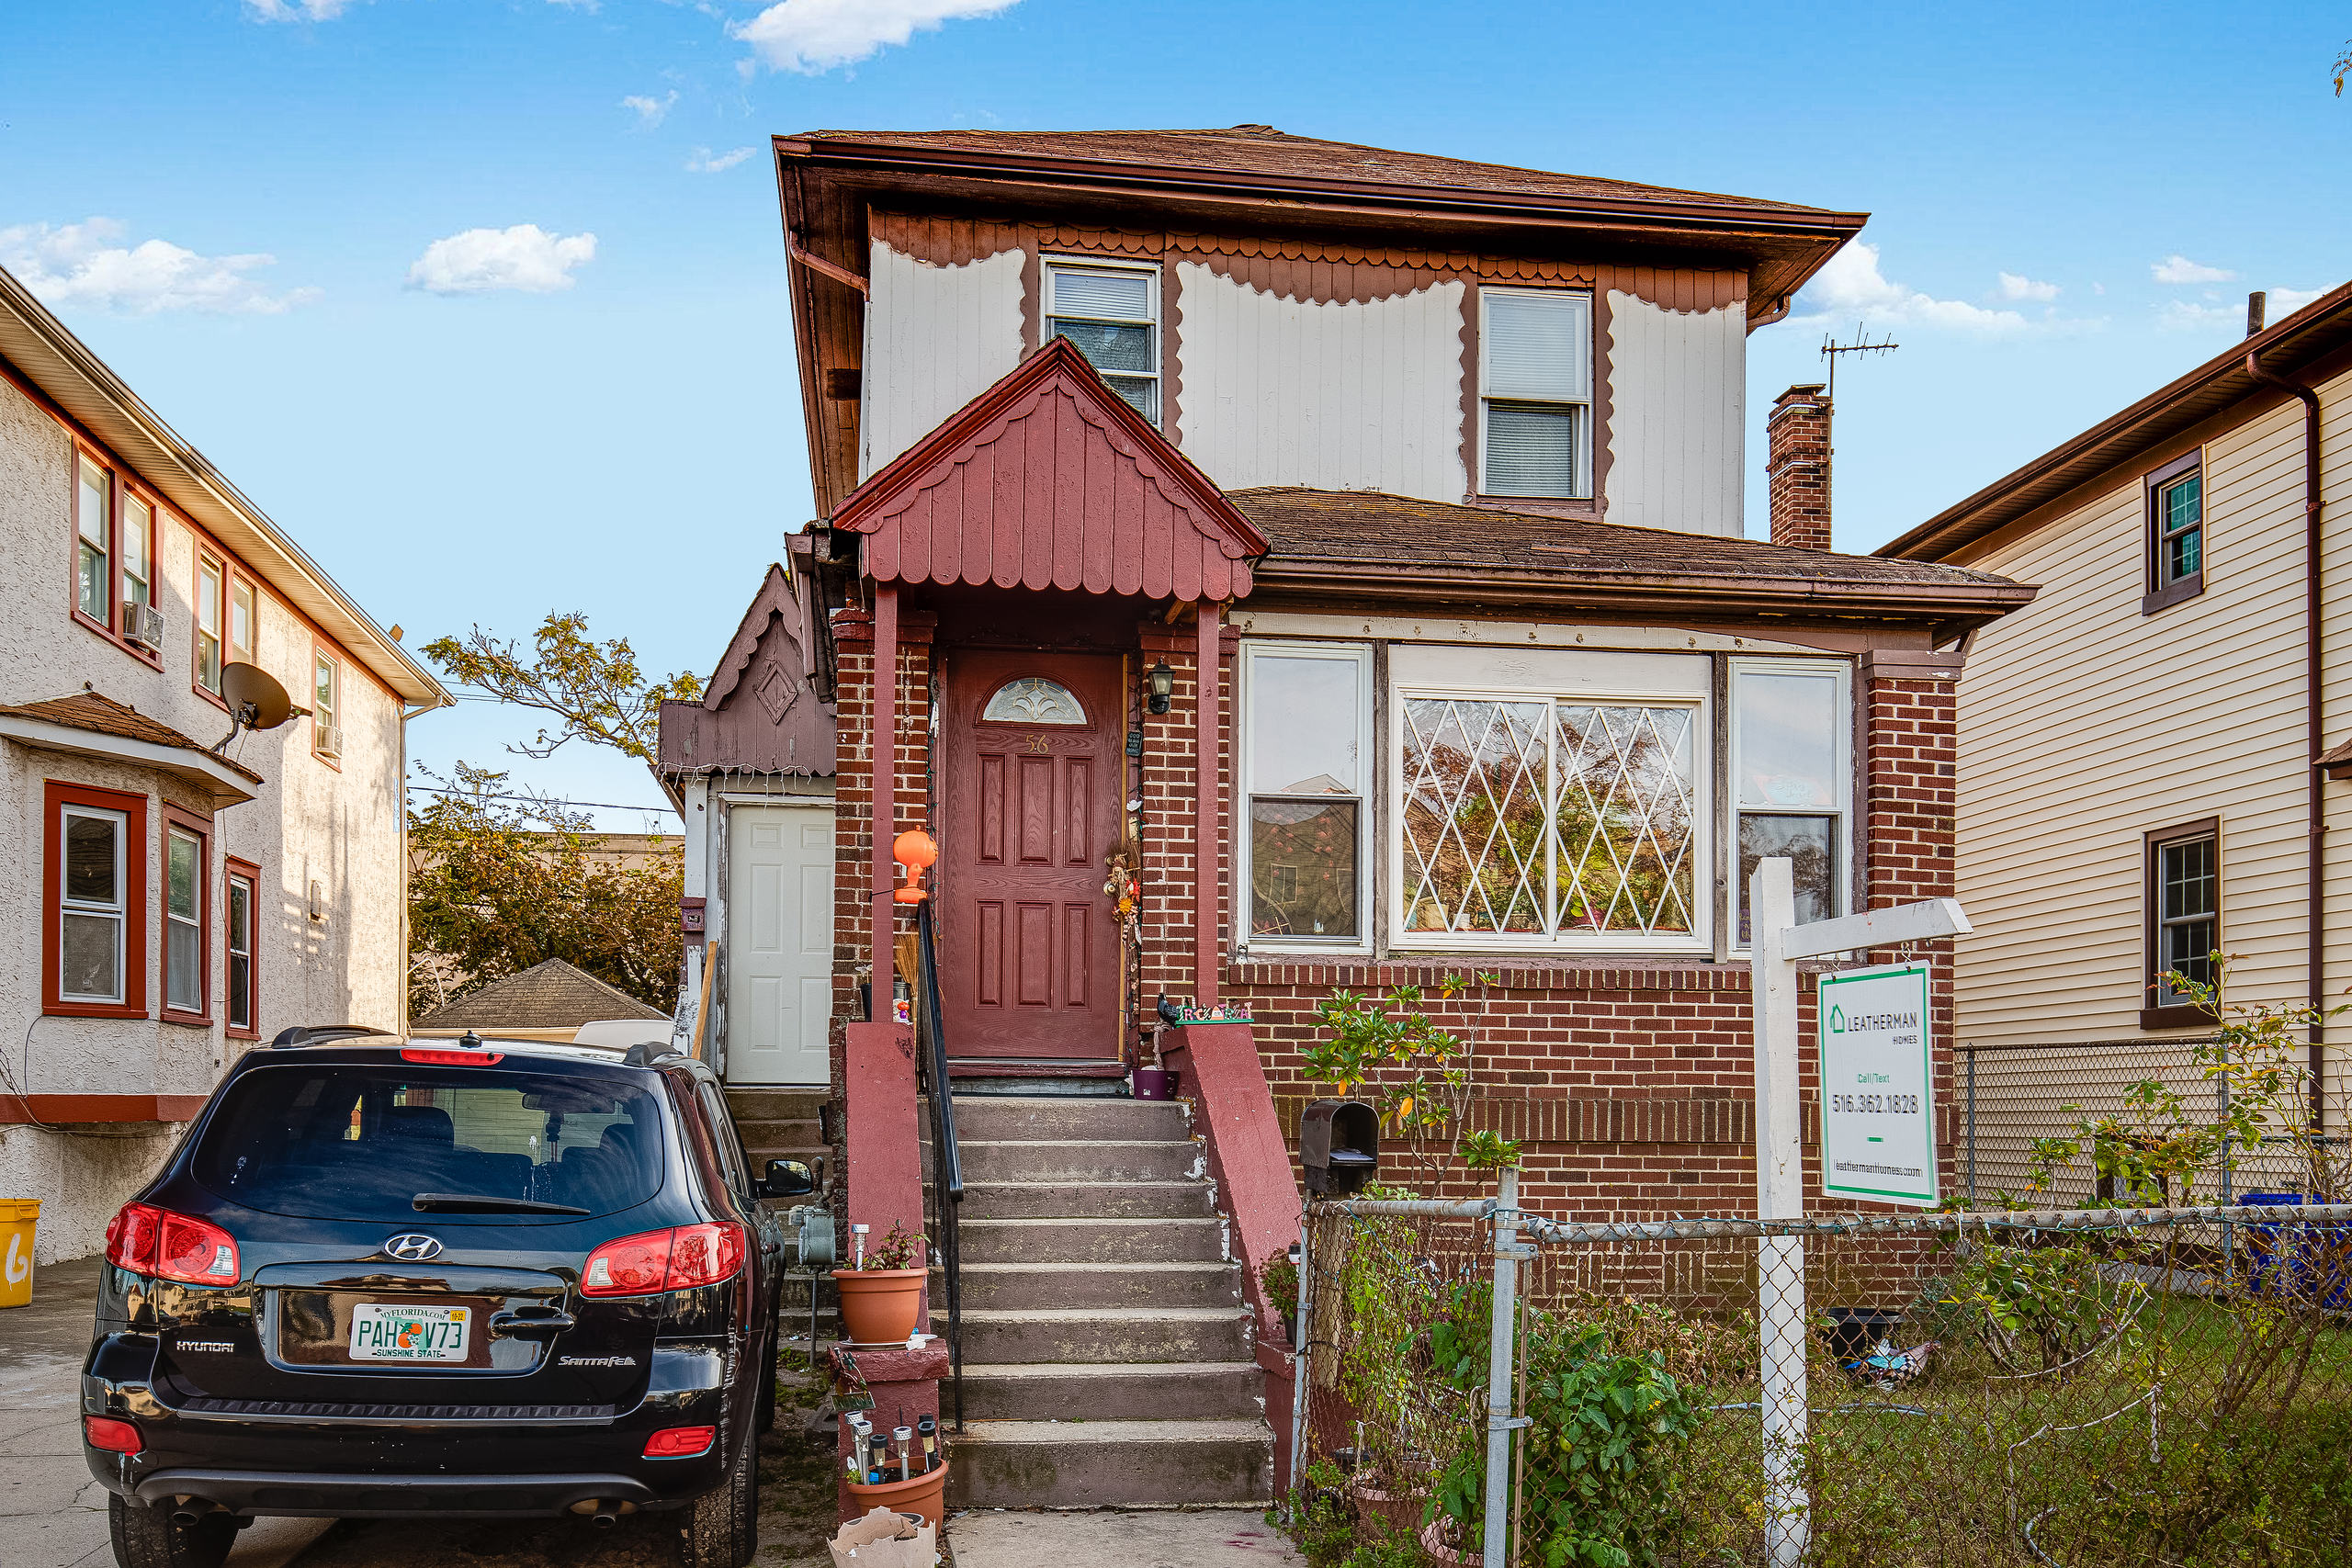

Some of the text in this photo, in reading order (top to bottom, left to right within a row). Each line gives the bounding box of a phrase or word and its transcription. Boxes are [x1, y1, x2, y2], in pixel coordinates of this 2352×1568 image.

[1025, 734, 1048, 754] 56
[1848, 1012, 1917, 1032] LEATHERMAN
[1893, 1035, 1917, 1045] HOMES
[1857, 1073, 1890, 1084] Call/Text
[1832, 1094, 1918, 1114] 516.362.1828
[6, 1233, 28, 1286] 6
[358, 1321, 462, 1348] PAH V73
[176, 1341, 234, 1352] HYUNDAI
[376, 1349, 414, 1358] SUNSHINE
